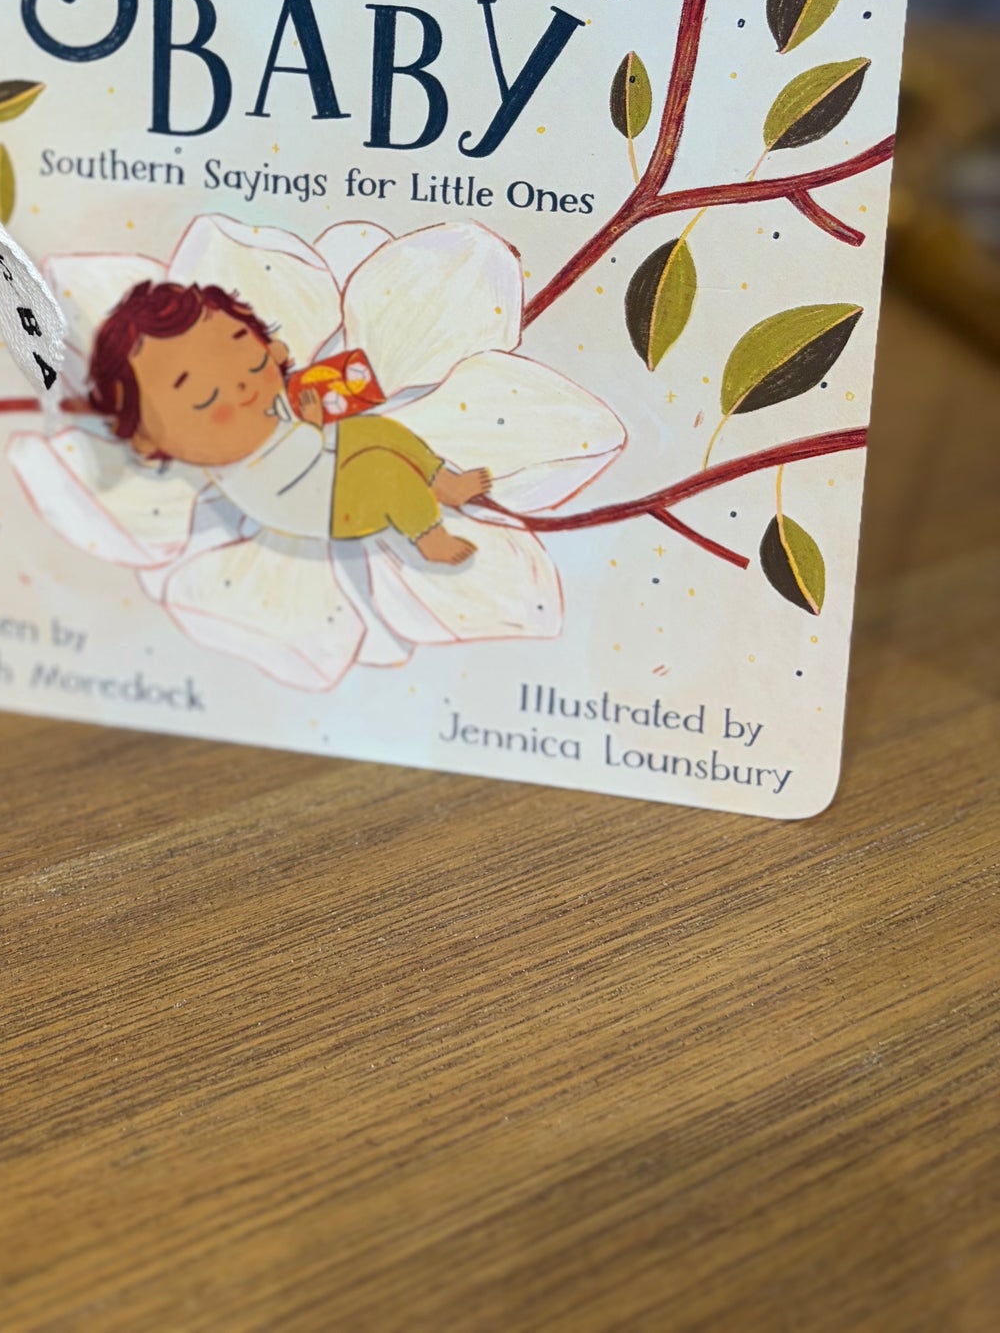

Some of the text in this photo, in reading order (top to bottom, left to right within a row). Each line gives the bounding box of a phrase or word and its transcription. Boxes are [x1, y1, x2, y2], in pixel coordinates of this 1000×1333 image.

[39, 148, 596, 215] Southern Sayings for Little Ones
[51, 617, 89, 654] by
[29, 663, 207, 713] Moredock
[518, 682, 765, 747] Illustrated by
[438, 711, 794, 794] Jennica Lounsbury
